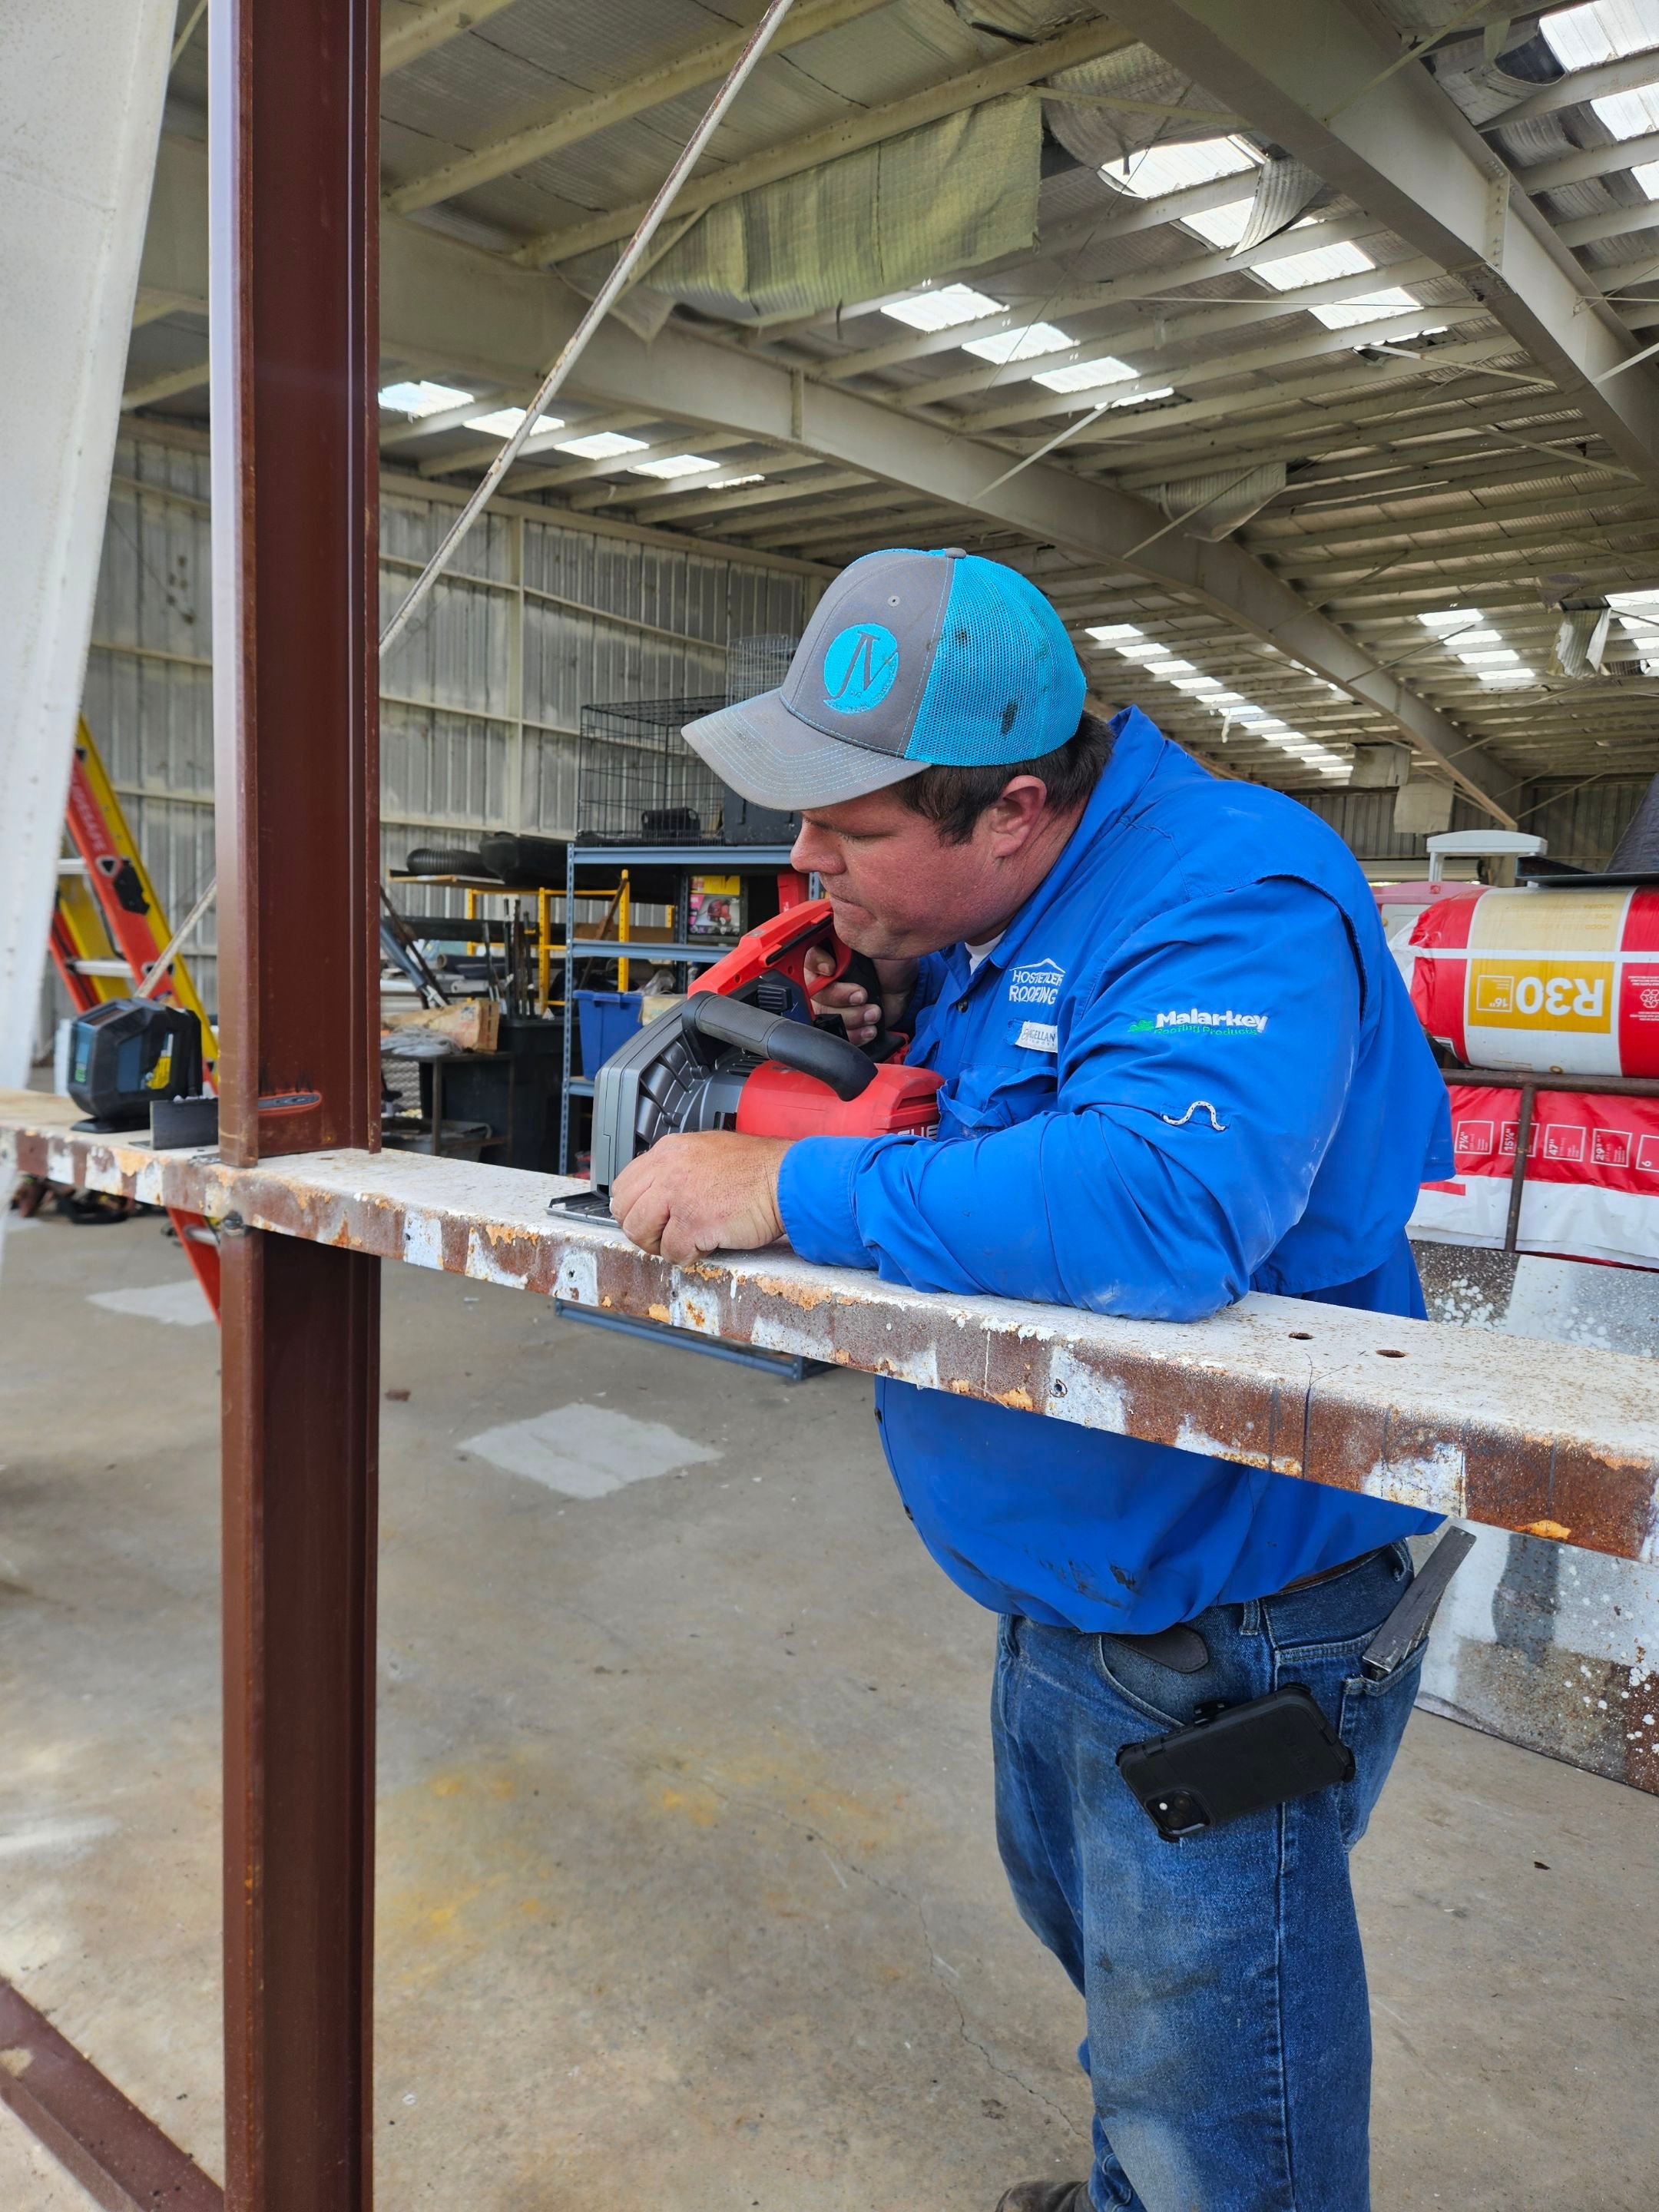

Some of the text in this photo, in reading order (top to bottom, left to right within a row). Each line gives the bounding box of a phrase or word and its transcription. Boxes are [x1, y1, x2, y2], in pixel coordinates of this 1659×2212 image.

[1008, 985, 1058, 1005] ROOFING
[1515, 975, 1605, 1018] R30
[1154, 1008, 1269, 1033] Malarkey
[1154, 1025, 1258, 1036] Roofing Products
